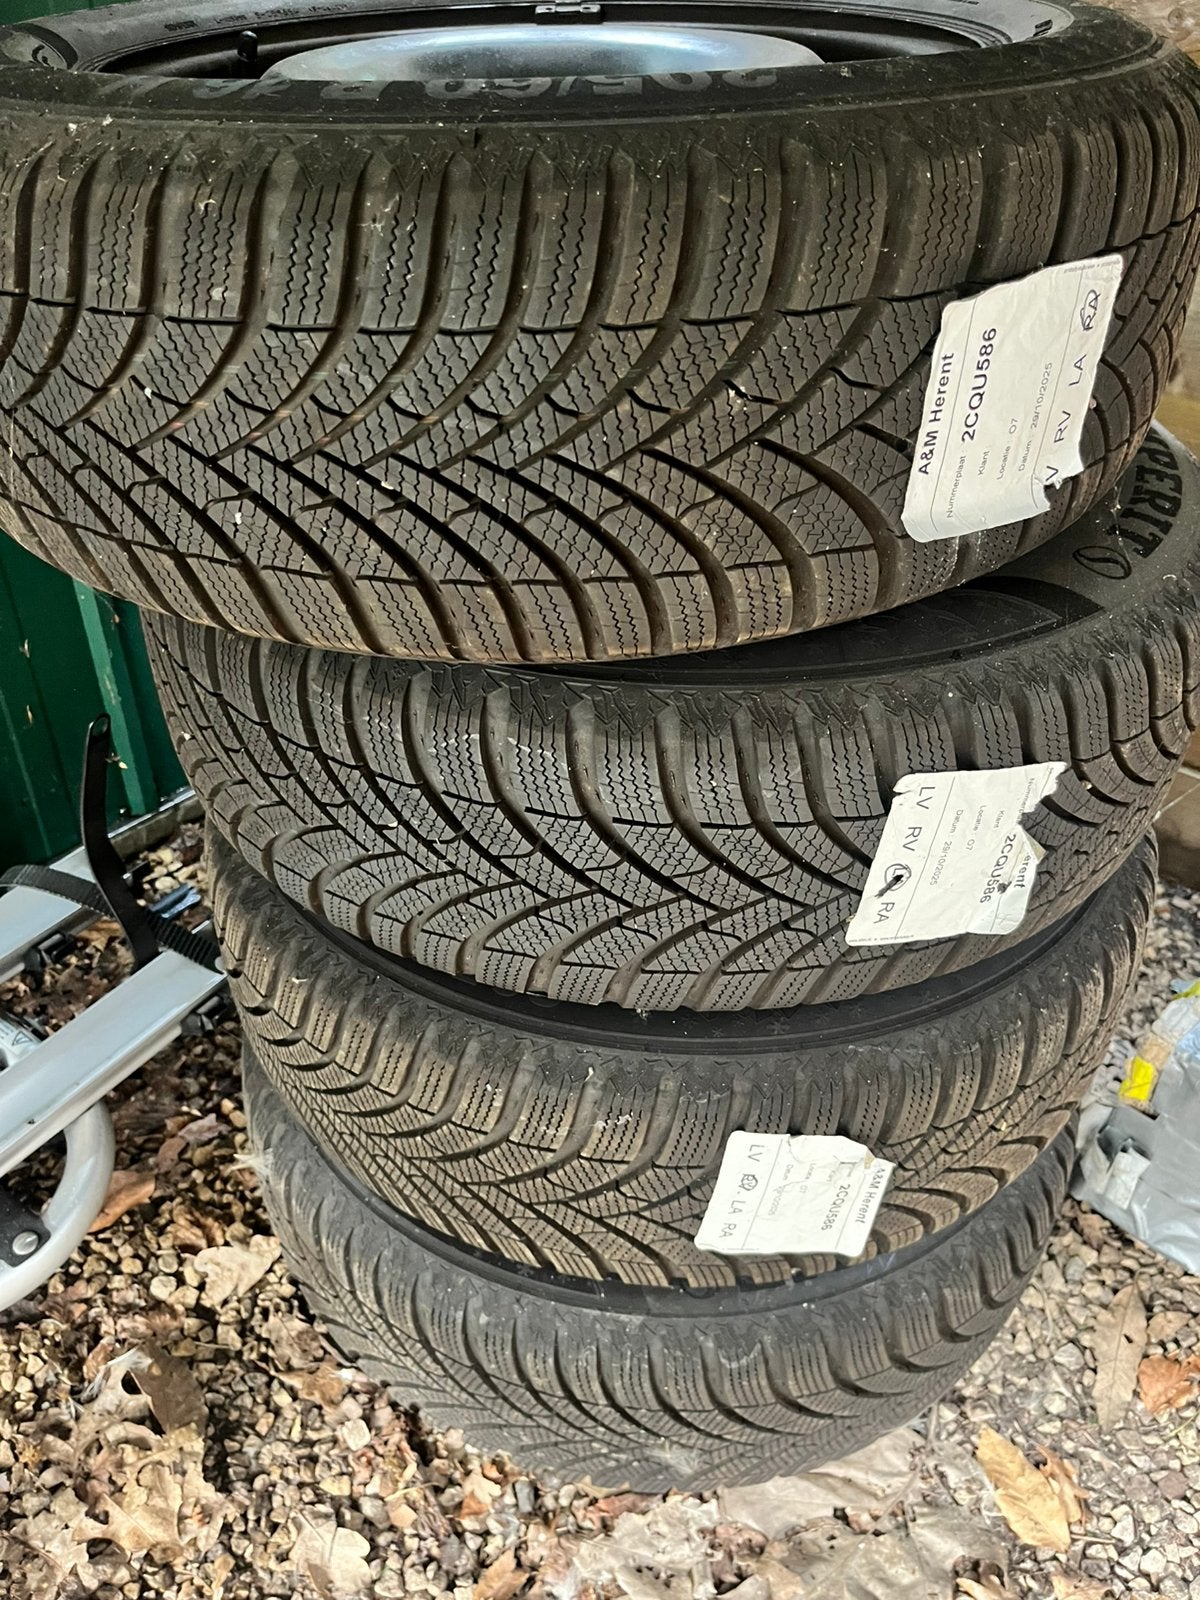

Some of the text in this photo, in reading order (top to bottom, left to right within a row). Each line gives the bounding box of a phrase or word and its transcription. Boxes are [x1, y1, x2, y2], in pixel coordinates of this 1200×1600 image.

[961, 327, 997, 443] 2CQU586
[1053, 410, 1072, 443] RV
[1068, 354, 1087, 386] LA
[918, 352, 955, 475] A&M Herent
[1018, 362, 1052, 472] Datum 29/10/2025
[916, 786, 936, 810] LV
[902, 826, 923, 852] RV
[980, 833, 1017, 903] 2CQU586
[1013, 852, 1032, 889] erent
[873, 902, 895, 924] RA
[747, 1144, 764, 1162] LV
[728, 1200, 746, 1215] LA
[855, 1191, 877, 1224] Herent
[718, 1222, 737, 1239] RA
